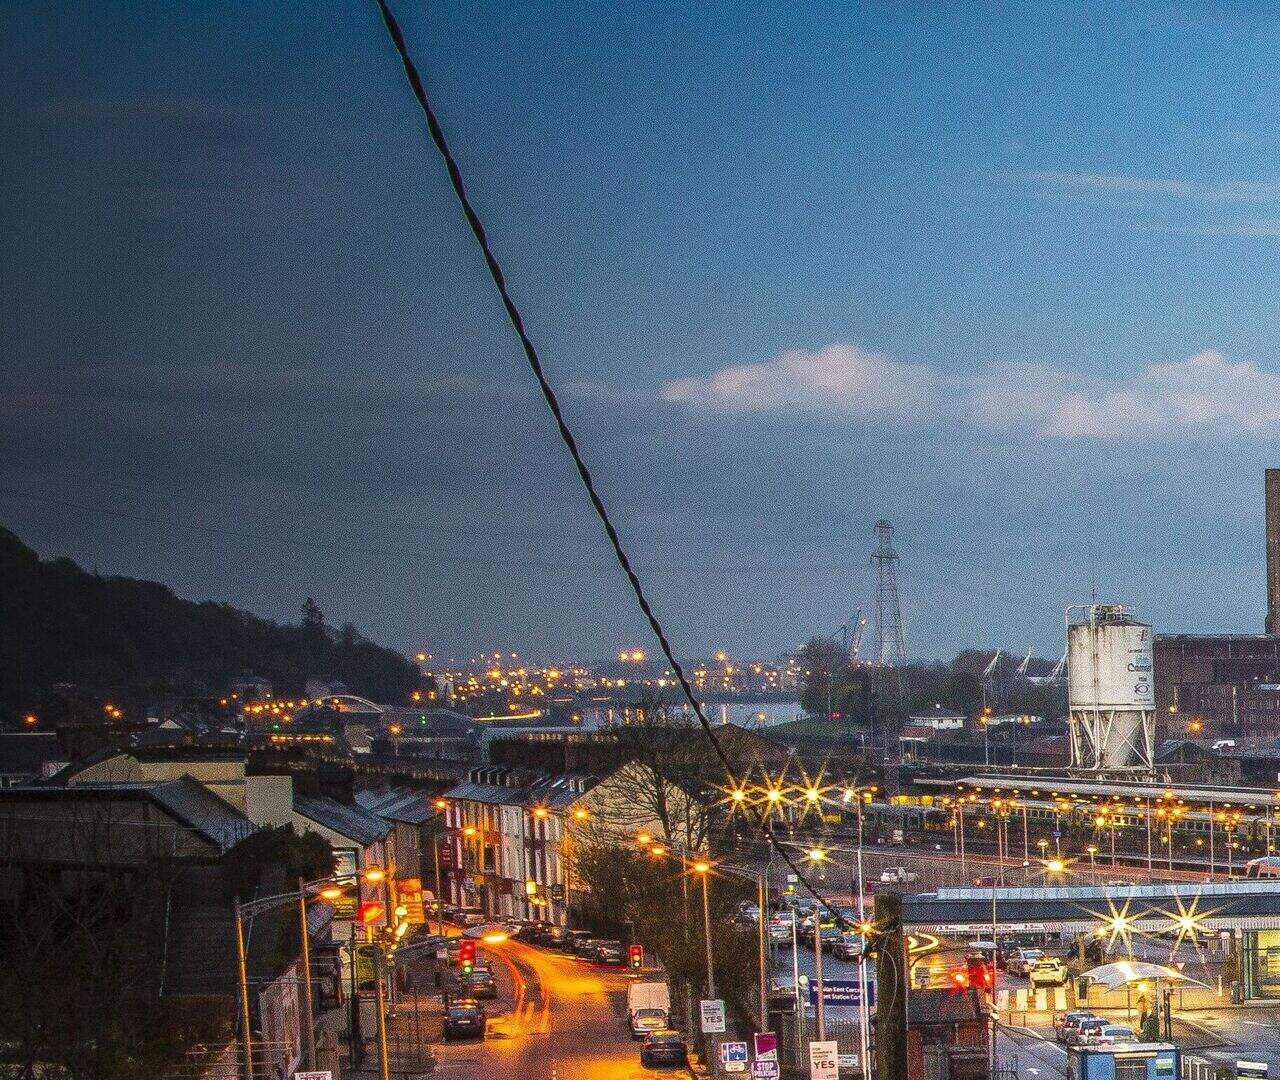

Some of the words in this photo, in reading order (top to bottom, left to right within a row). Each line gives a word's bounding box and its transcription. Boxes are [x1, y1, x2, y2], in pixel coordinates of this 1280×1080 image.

[704, 1015, 723, 1023] YES
[756, 1062, 774, 1070] STOP
[813, 1060, 835, 1069] YES
